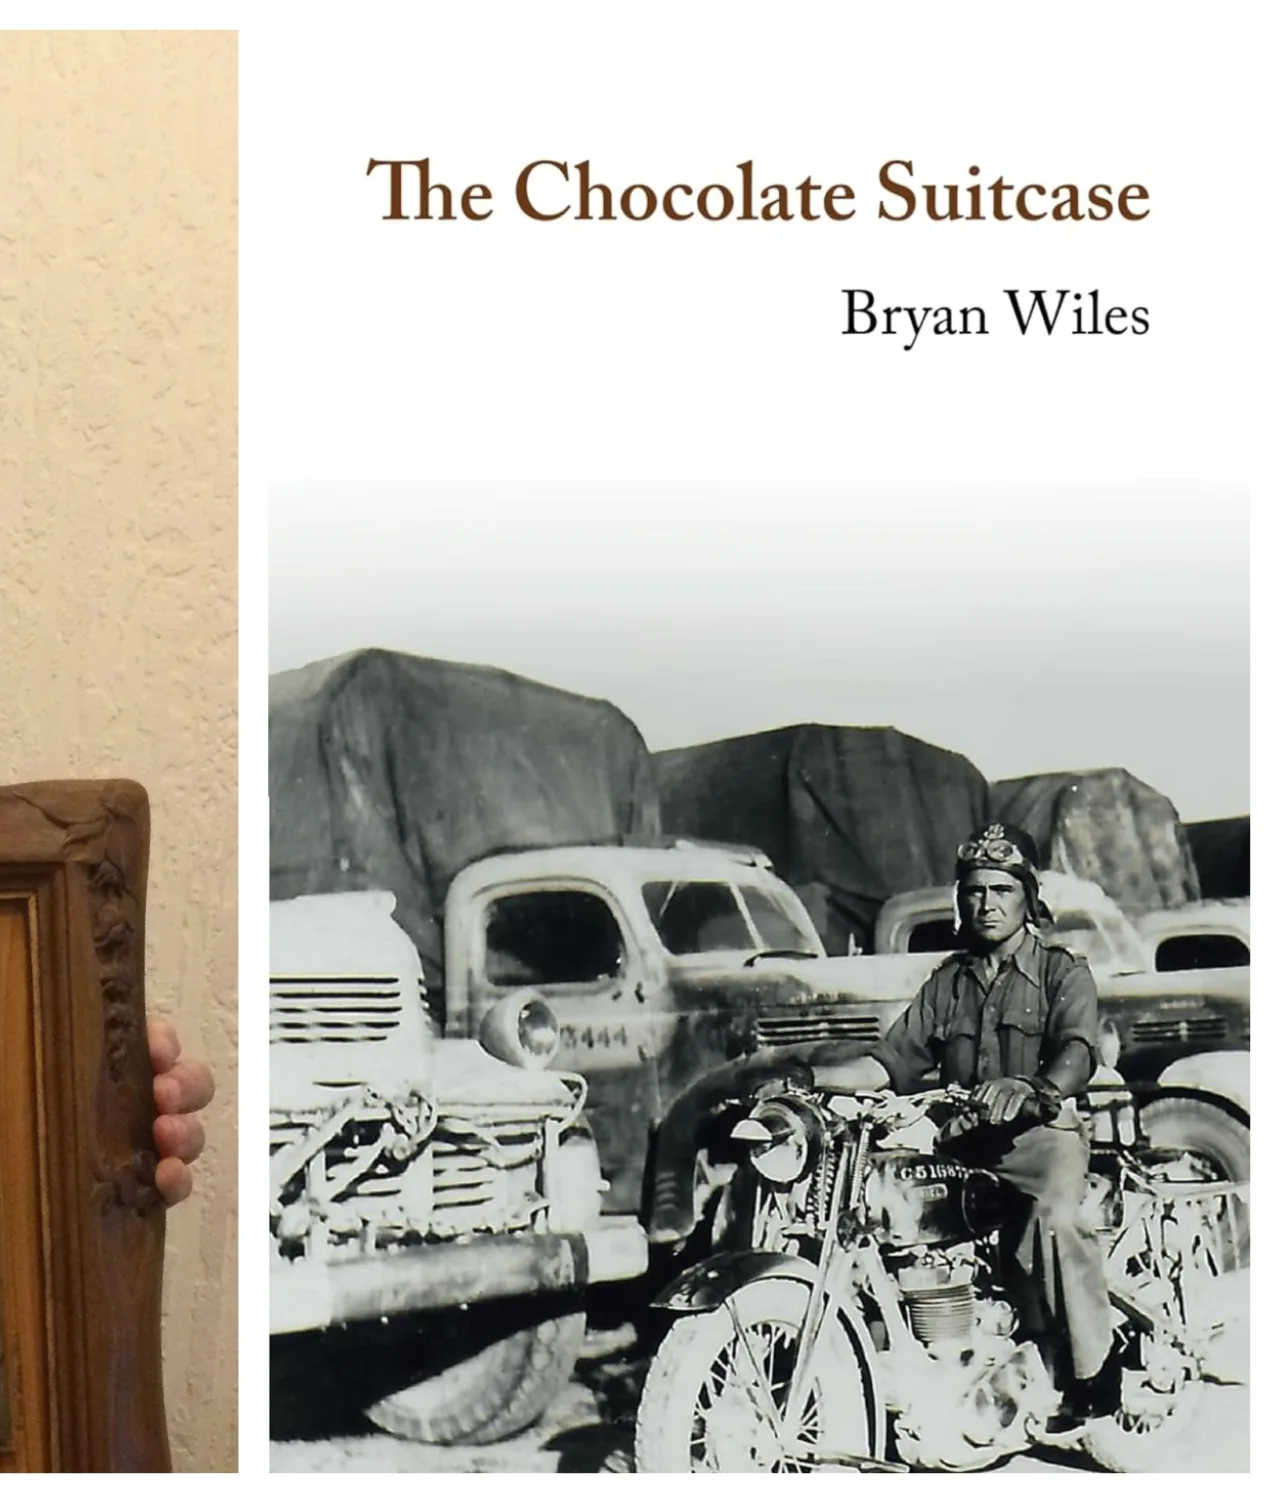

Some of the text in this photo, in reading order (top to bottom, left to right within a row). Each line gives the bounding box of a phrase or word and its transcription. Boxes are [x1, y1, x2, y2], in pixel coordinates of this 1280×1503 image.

[366, 158, 1149, 221] The Chocolate Suitcase
[842, 290, 1149, 351] Bryan Wiles
